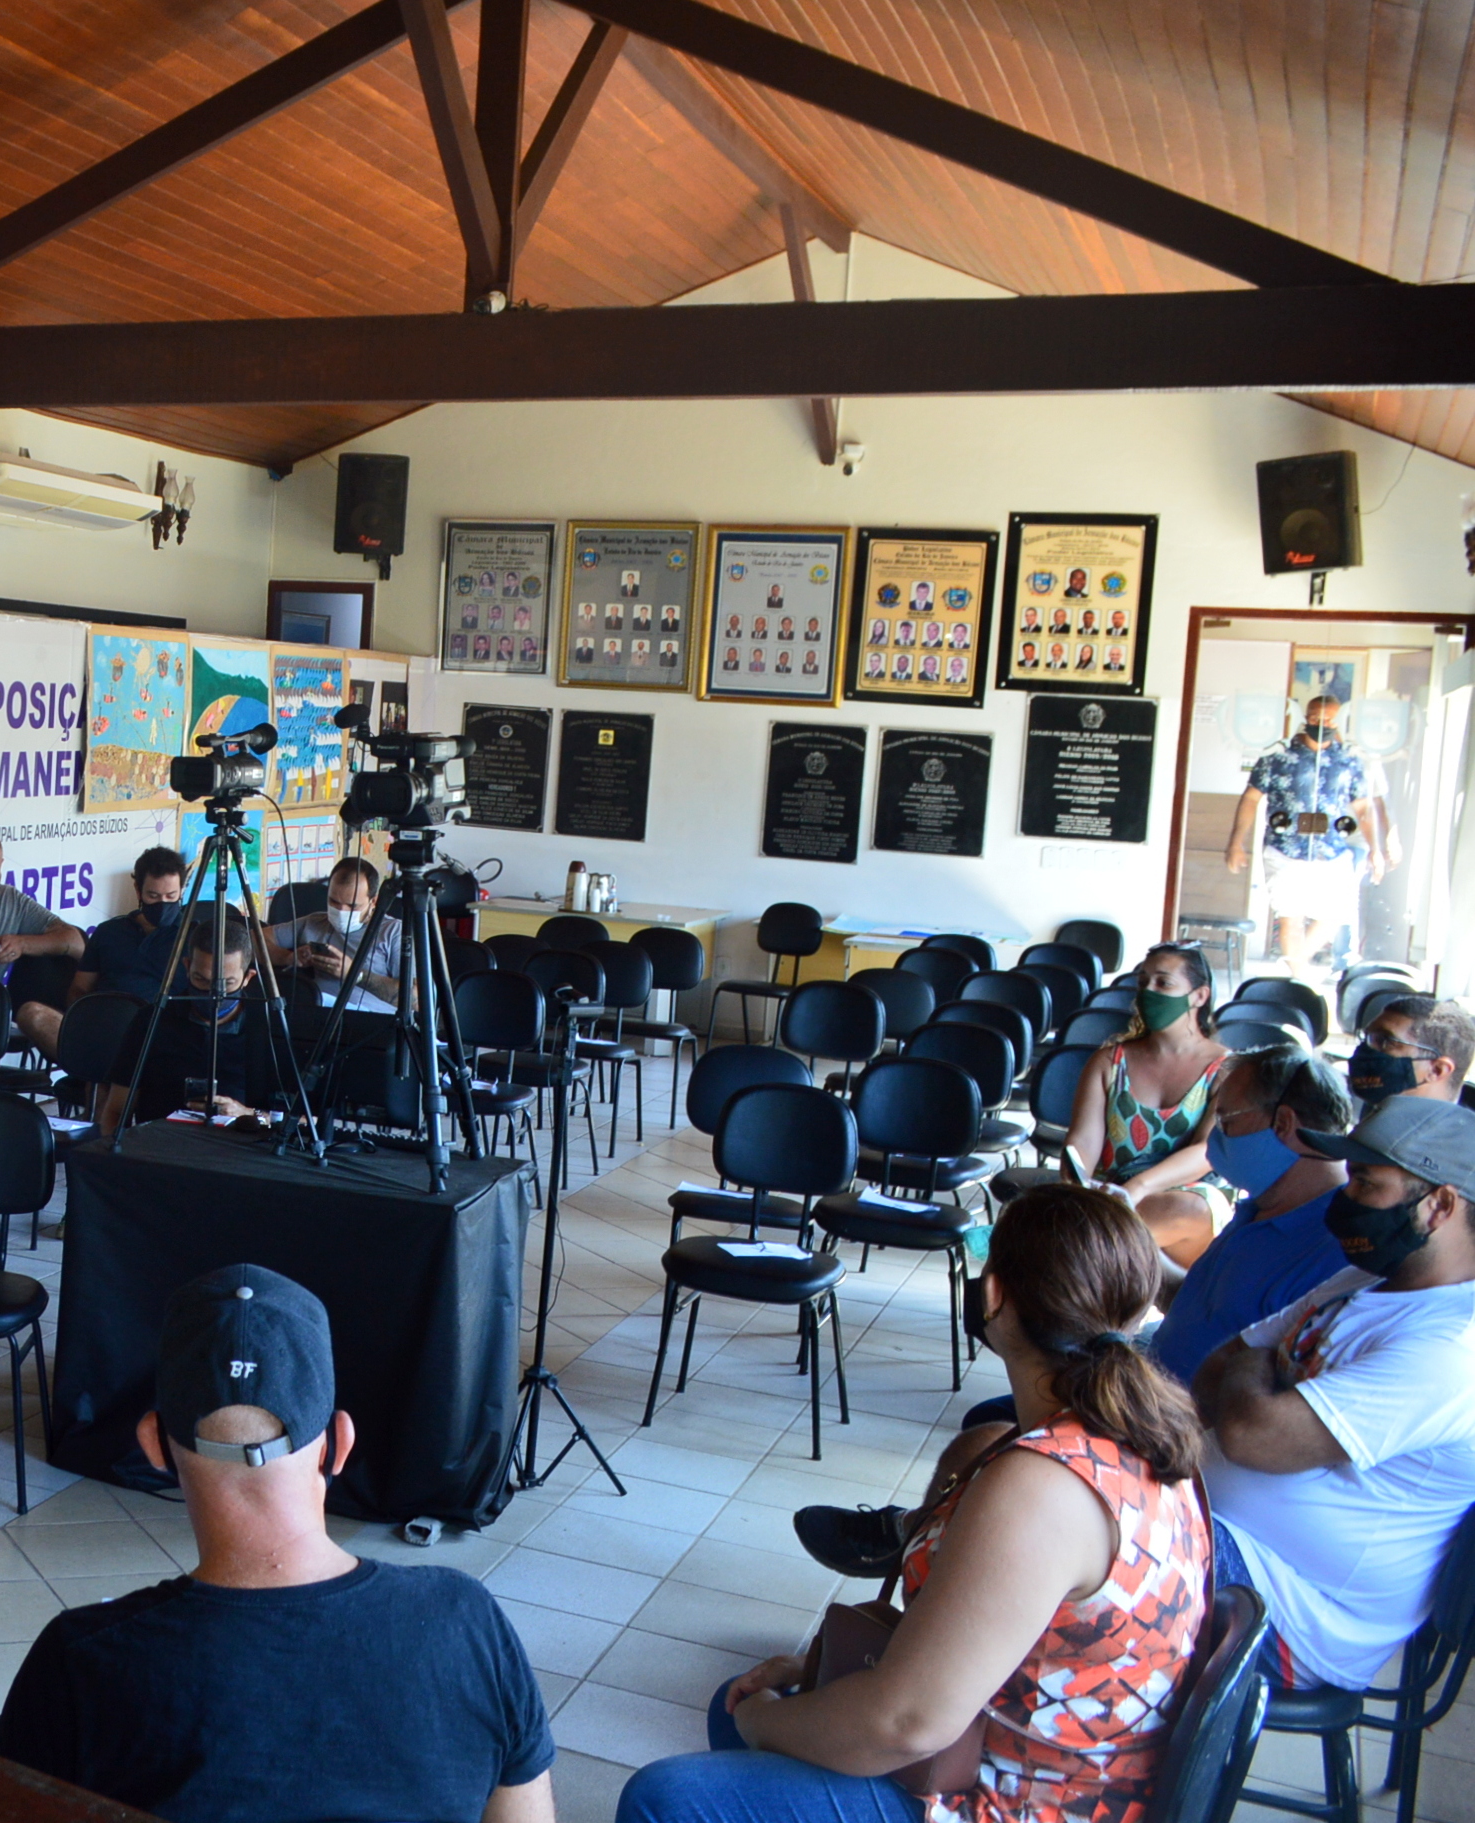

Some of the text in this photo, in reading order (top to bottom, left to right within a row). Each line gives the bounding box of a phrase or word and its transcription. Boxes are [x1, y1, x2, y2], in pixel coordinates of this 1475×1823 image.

[19, 824, 33, 840] DE
[34, 818, 78, 842] ARMAÇÃO
[79, 819, 97, 836] DOS
[98, 814, 128, 834] BÚZIOS
